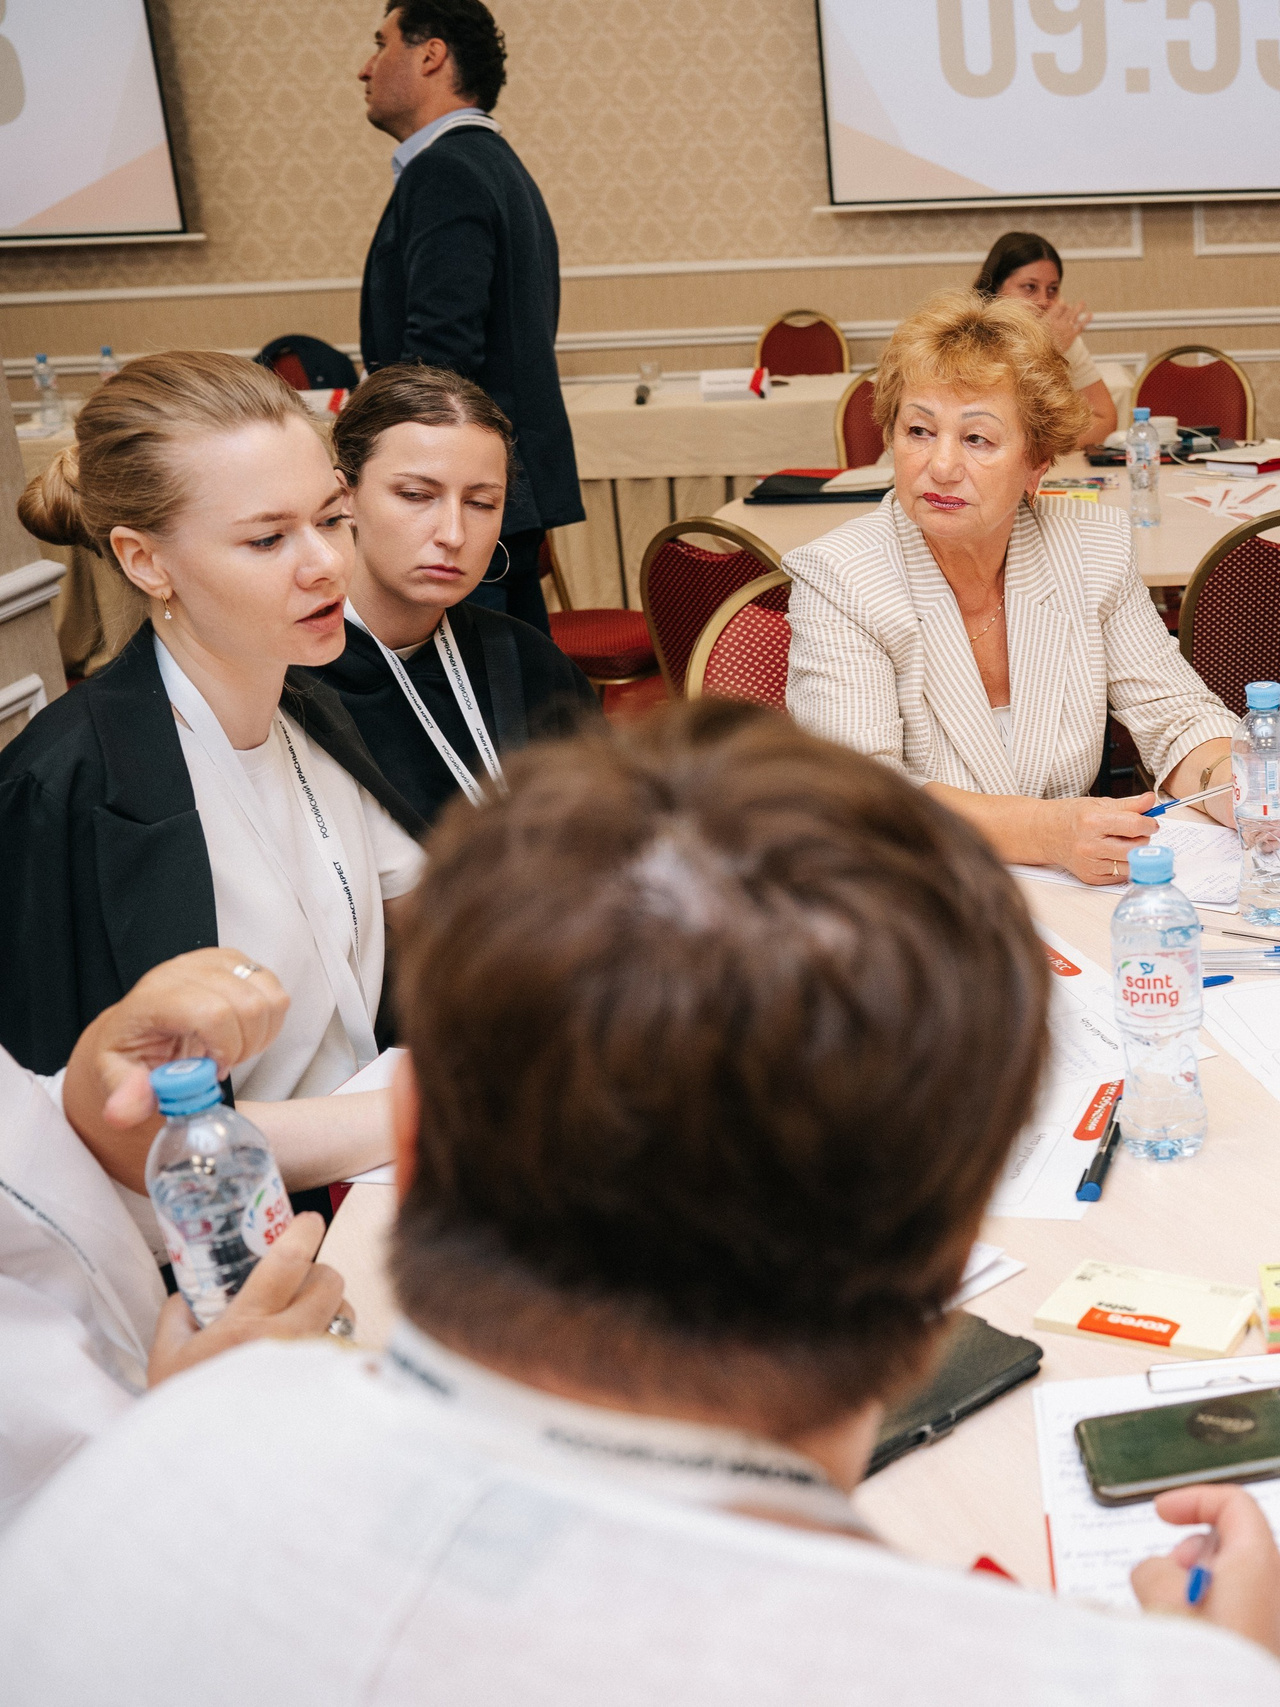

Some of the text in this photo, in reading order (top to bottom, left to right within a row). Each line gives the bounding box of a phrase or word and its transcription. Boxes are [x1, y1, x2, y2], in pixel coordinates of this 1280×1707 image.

[440, 635, 457, 668] КРАСНЫЙ
[403, 680, 422, 711] КРАСНЫЙ
[420, 710, 435, 730] КРЕСТ
[452, 667, 474, 711] РОССИЙСКИЙ
[476, 727, 488, 747] КРЕСТ
[287, 743, 308, 785] КРАСНЫЙ
[442, 745, 470, 785] РОССИЙСКИЙ
[302, 783, 329, 839] РОССИЙСКИЙ
[333, 861, 348, 886] КРЕСТ
[342, 885, 358, 926] КРАСНЫЙ
[1122, 988, 1180, 1008] spring
[1126, 974, 1173, 989] saint
[1081, 1017, 1119, 1051] Что улучшить
[1010, 1133, 1047, 1180] Что улучшить
